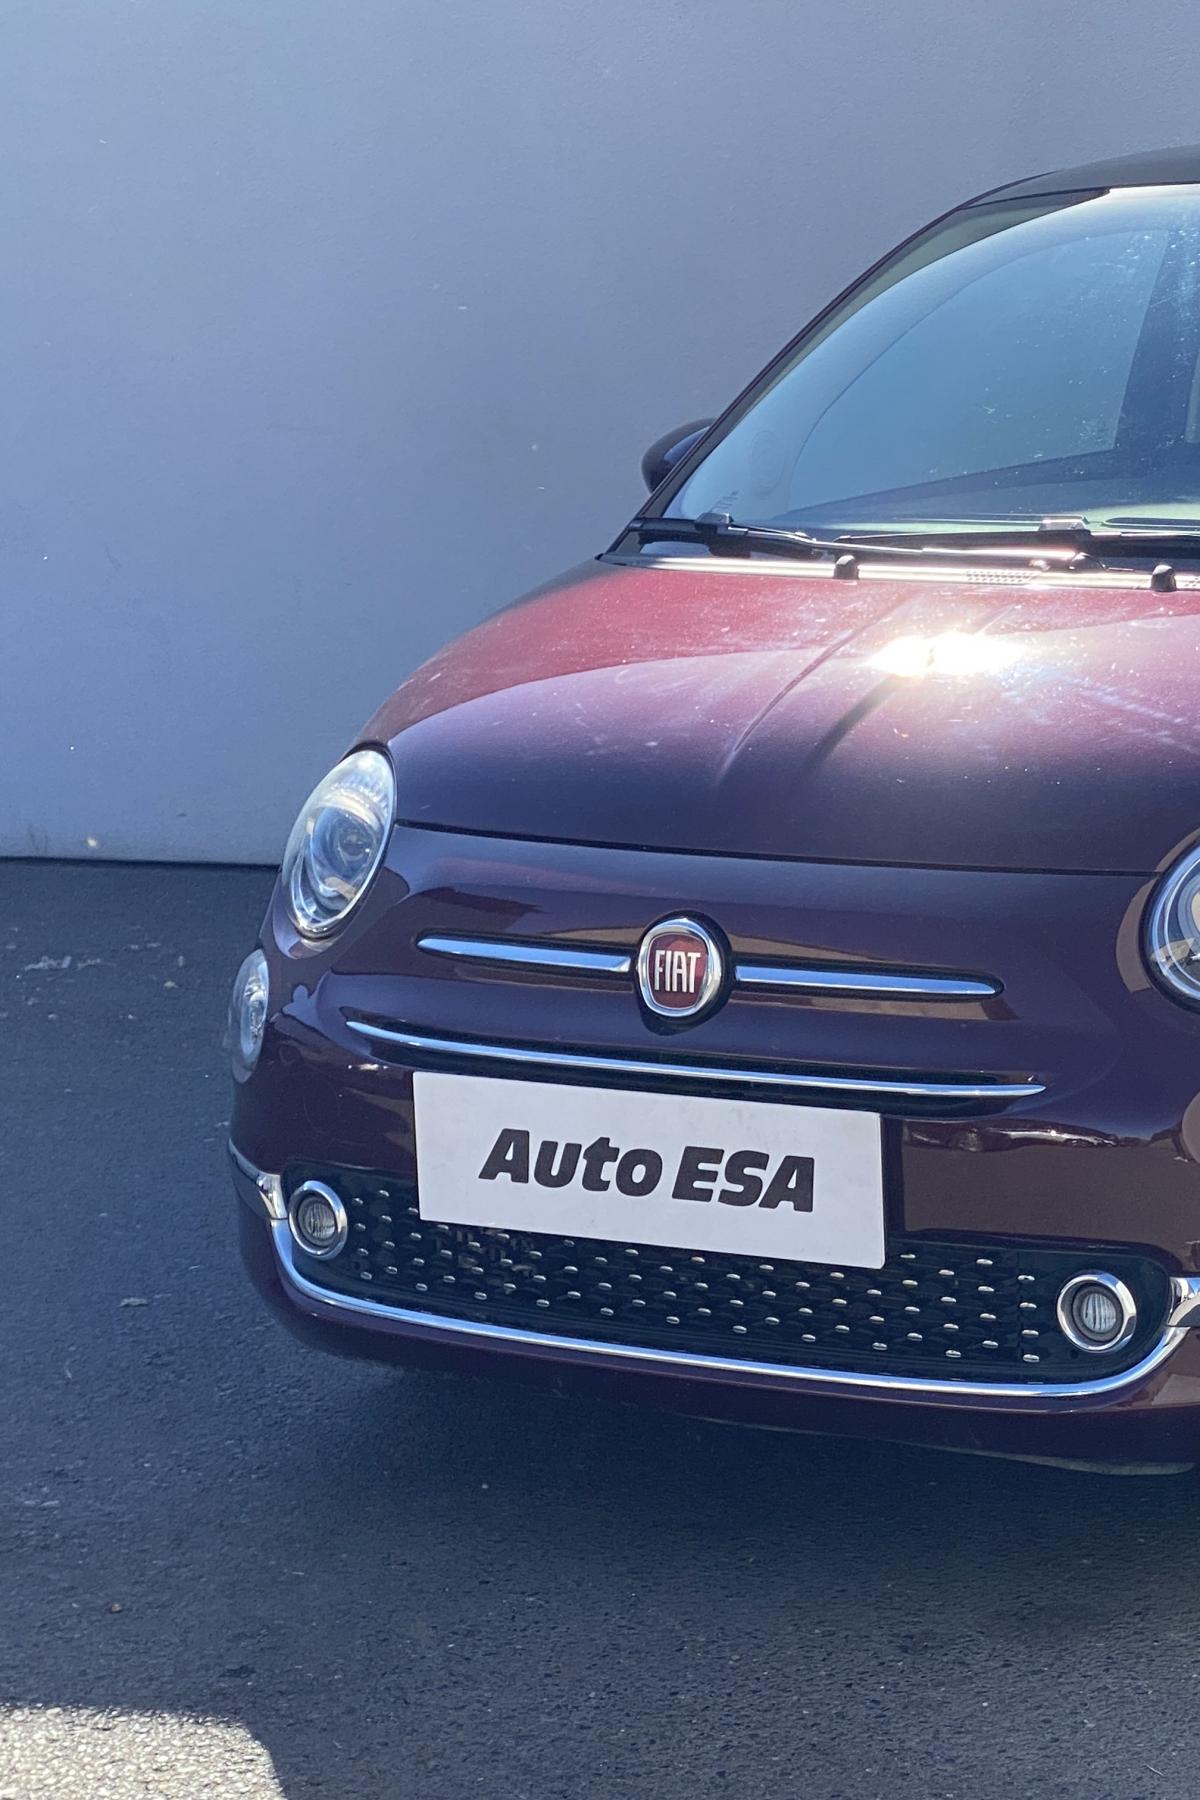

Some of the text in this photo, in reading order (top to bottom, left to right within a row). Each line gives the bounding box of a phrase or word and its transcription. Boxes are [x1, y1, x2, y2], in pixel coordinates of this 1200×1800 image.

[654, 949, 701, 994] FIAT
[478, 1128, 815, 1213] Auto ESA
